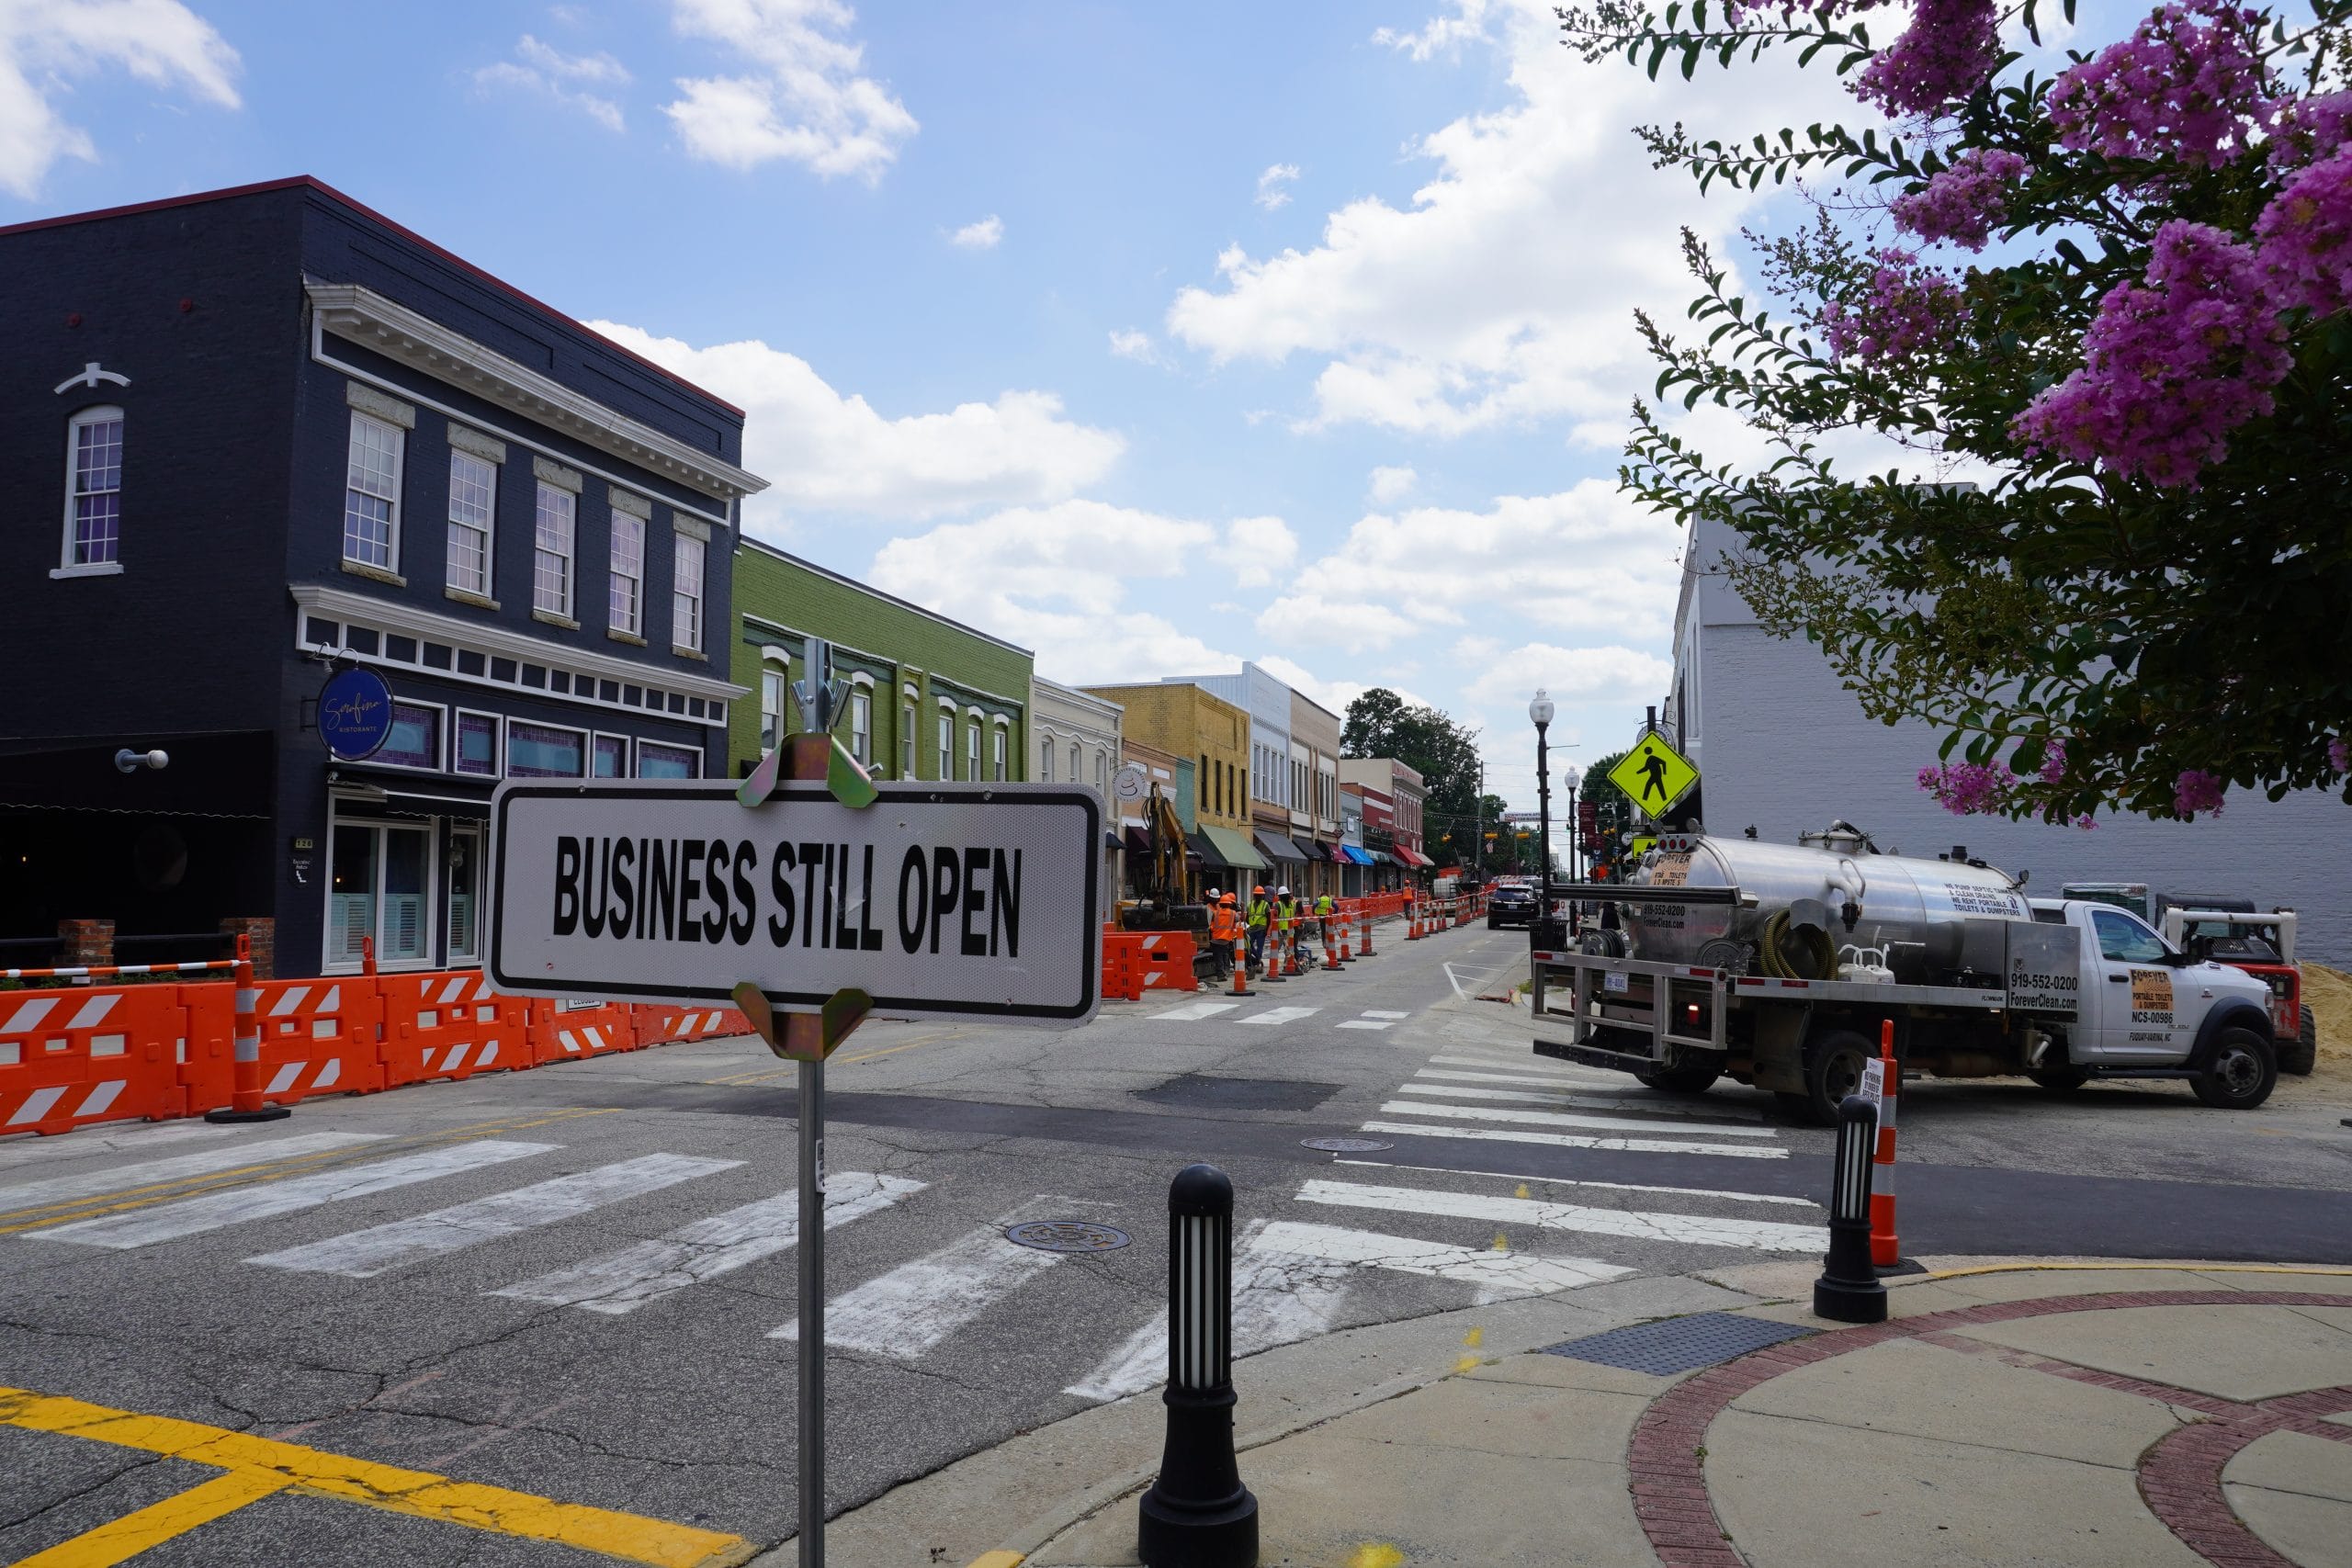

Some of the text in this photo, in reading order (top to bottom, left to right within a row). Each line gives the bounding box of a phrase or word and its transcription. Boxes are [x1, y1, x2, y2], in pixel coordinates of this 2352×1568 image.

[1655, 853, 1690, 867] FOREVER
[553, 836, 1022, 957] BUSINESS STILL OPEN
[1979, 899, 2007, 908] PORTABLE
[1644, 904, 1685, 918] 919-552-0200
[1954, 904, 1979, 912] TOILETS
[1987, 907, 2020, 916] DUMPSTERS
[2011, 974, 2077, 990] 919-552-0200
[2131, 969, 2168, 986] FOREVER
[2010, 992, 2076, 1009] ForeverClean.com
[2132, 1011, 2173, 1023] NCS-00986
[2165, 1033, 2171, 1042] NC
